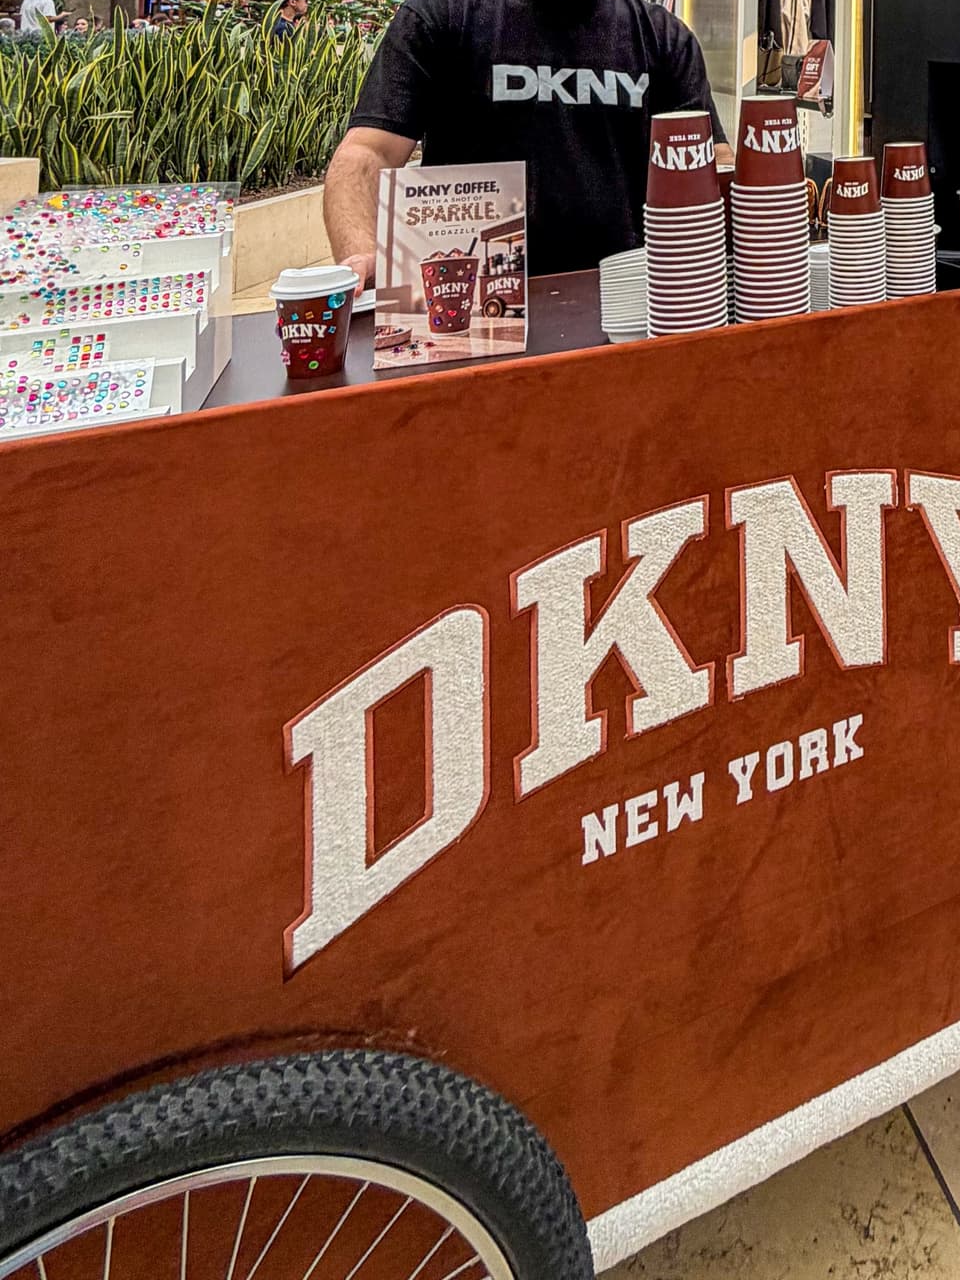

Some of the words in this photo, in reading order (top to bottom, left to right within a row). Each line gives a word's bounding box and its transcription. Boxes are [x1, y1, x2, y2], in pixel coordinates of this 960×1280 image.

[492, 64, 650, 108] DKNY
[651, 135, 715, 171] DKNY
[893, 165, 925, 181] DKNY
[405, 184, 452, 198] DKNY
[454, 180, 500, 195] COFFEE,
[836, 182, 869, 198] DKNY
[406, 201, 500, 226] SPARKLE.
[432, 282, 469, 297] DKNY
[486, 277, 521, 295] DKNY
[281, 323, 328, 340] DKNY
[581, 772, 705, 866] NEW
[728, 714, 865, 804] YORK
